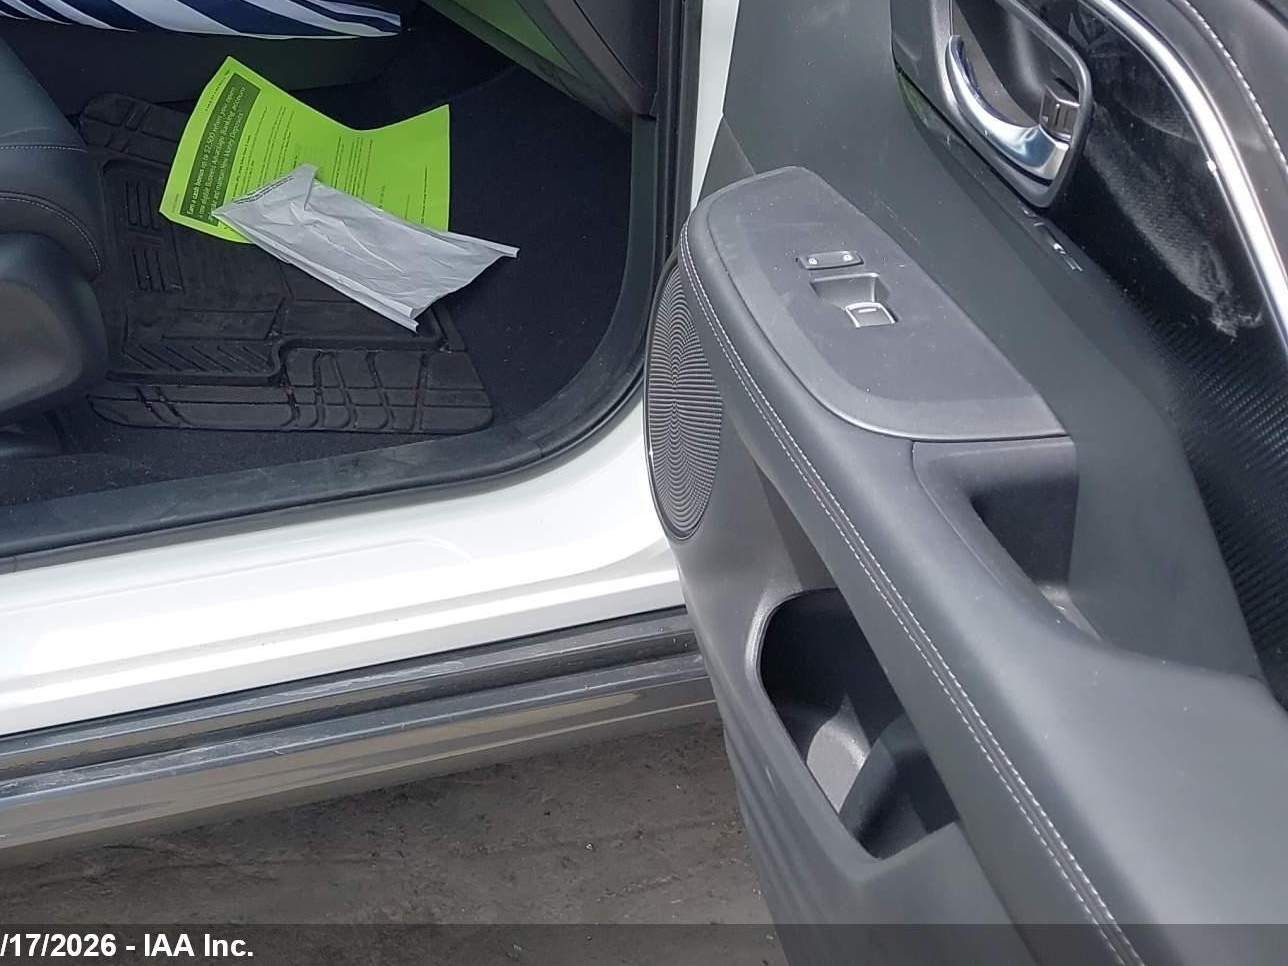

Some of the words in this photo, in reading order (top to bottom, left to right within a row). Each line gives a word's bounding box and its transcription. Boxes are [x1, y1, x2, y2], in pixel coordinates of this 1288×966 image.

[194, 169, 204, 186] bonus
[212, 115, 222, 132] when
[226, 87, 234, 102] open
[212, 136, 225, 164] Advantage
[221, 111, 235, 135] Banking
[232, 87, 246, 111] account
[223, 137, 235, 156] Money
